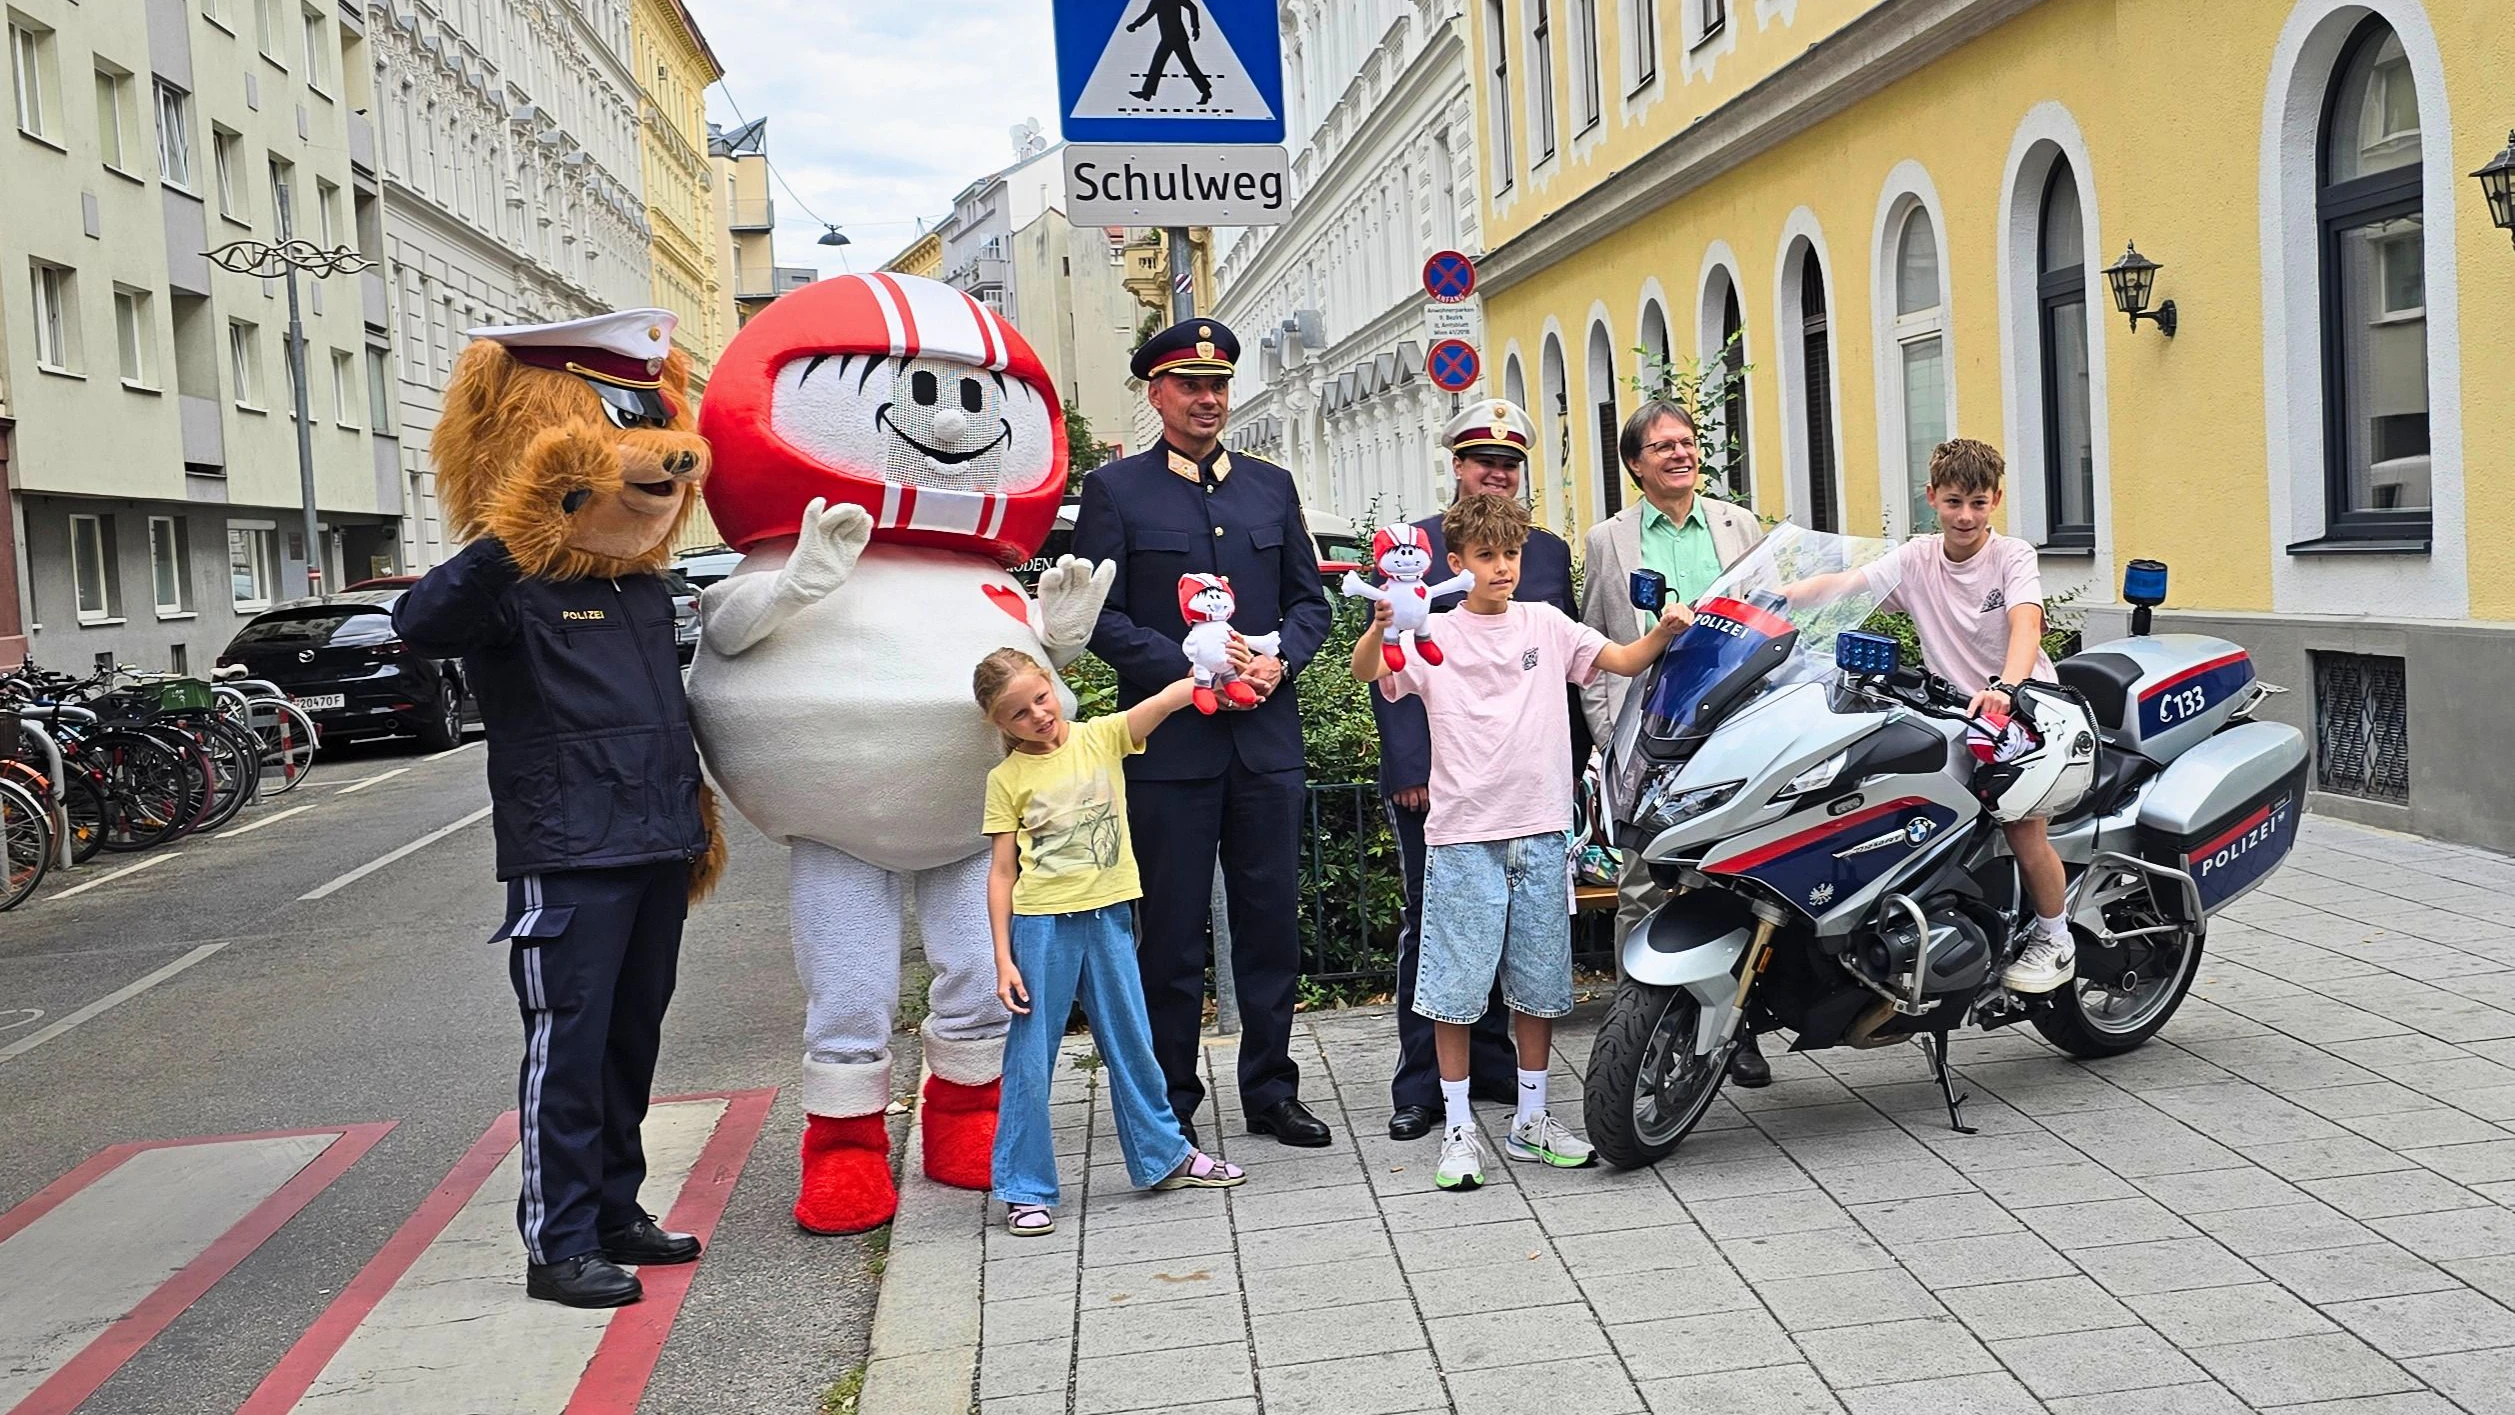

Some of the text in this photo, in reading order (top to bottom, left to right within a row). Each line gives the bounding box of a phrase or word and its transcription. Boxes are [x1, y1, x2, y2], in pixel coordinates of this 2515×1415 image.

[1074, 162, 1283, 209] Schulweg
[1435, 293, 1465, 303] ANFANG
[1006, 558, 1054, 572] ODEN
[562, 610, 605, 620] POLIZEI
[1692, 613, 1750, 640] POLIZEI
[2173, 685, 2205, 719] 133
[2202, 816, 2275, 877] POLIZEI
